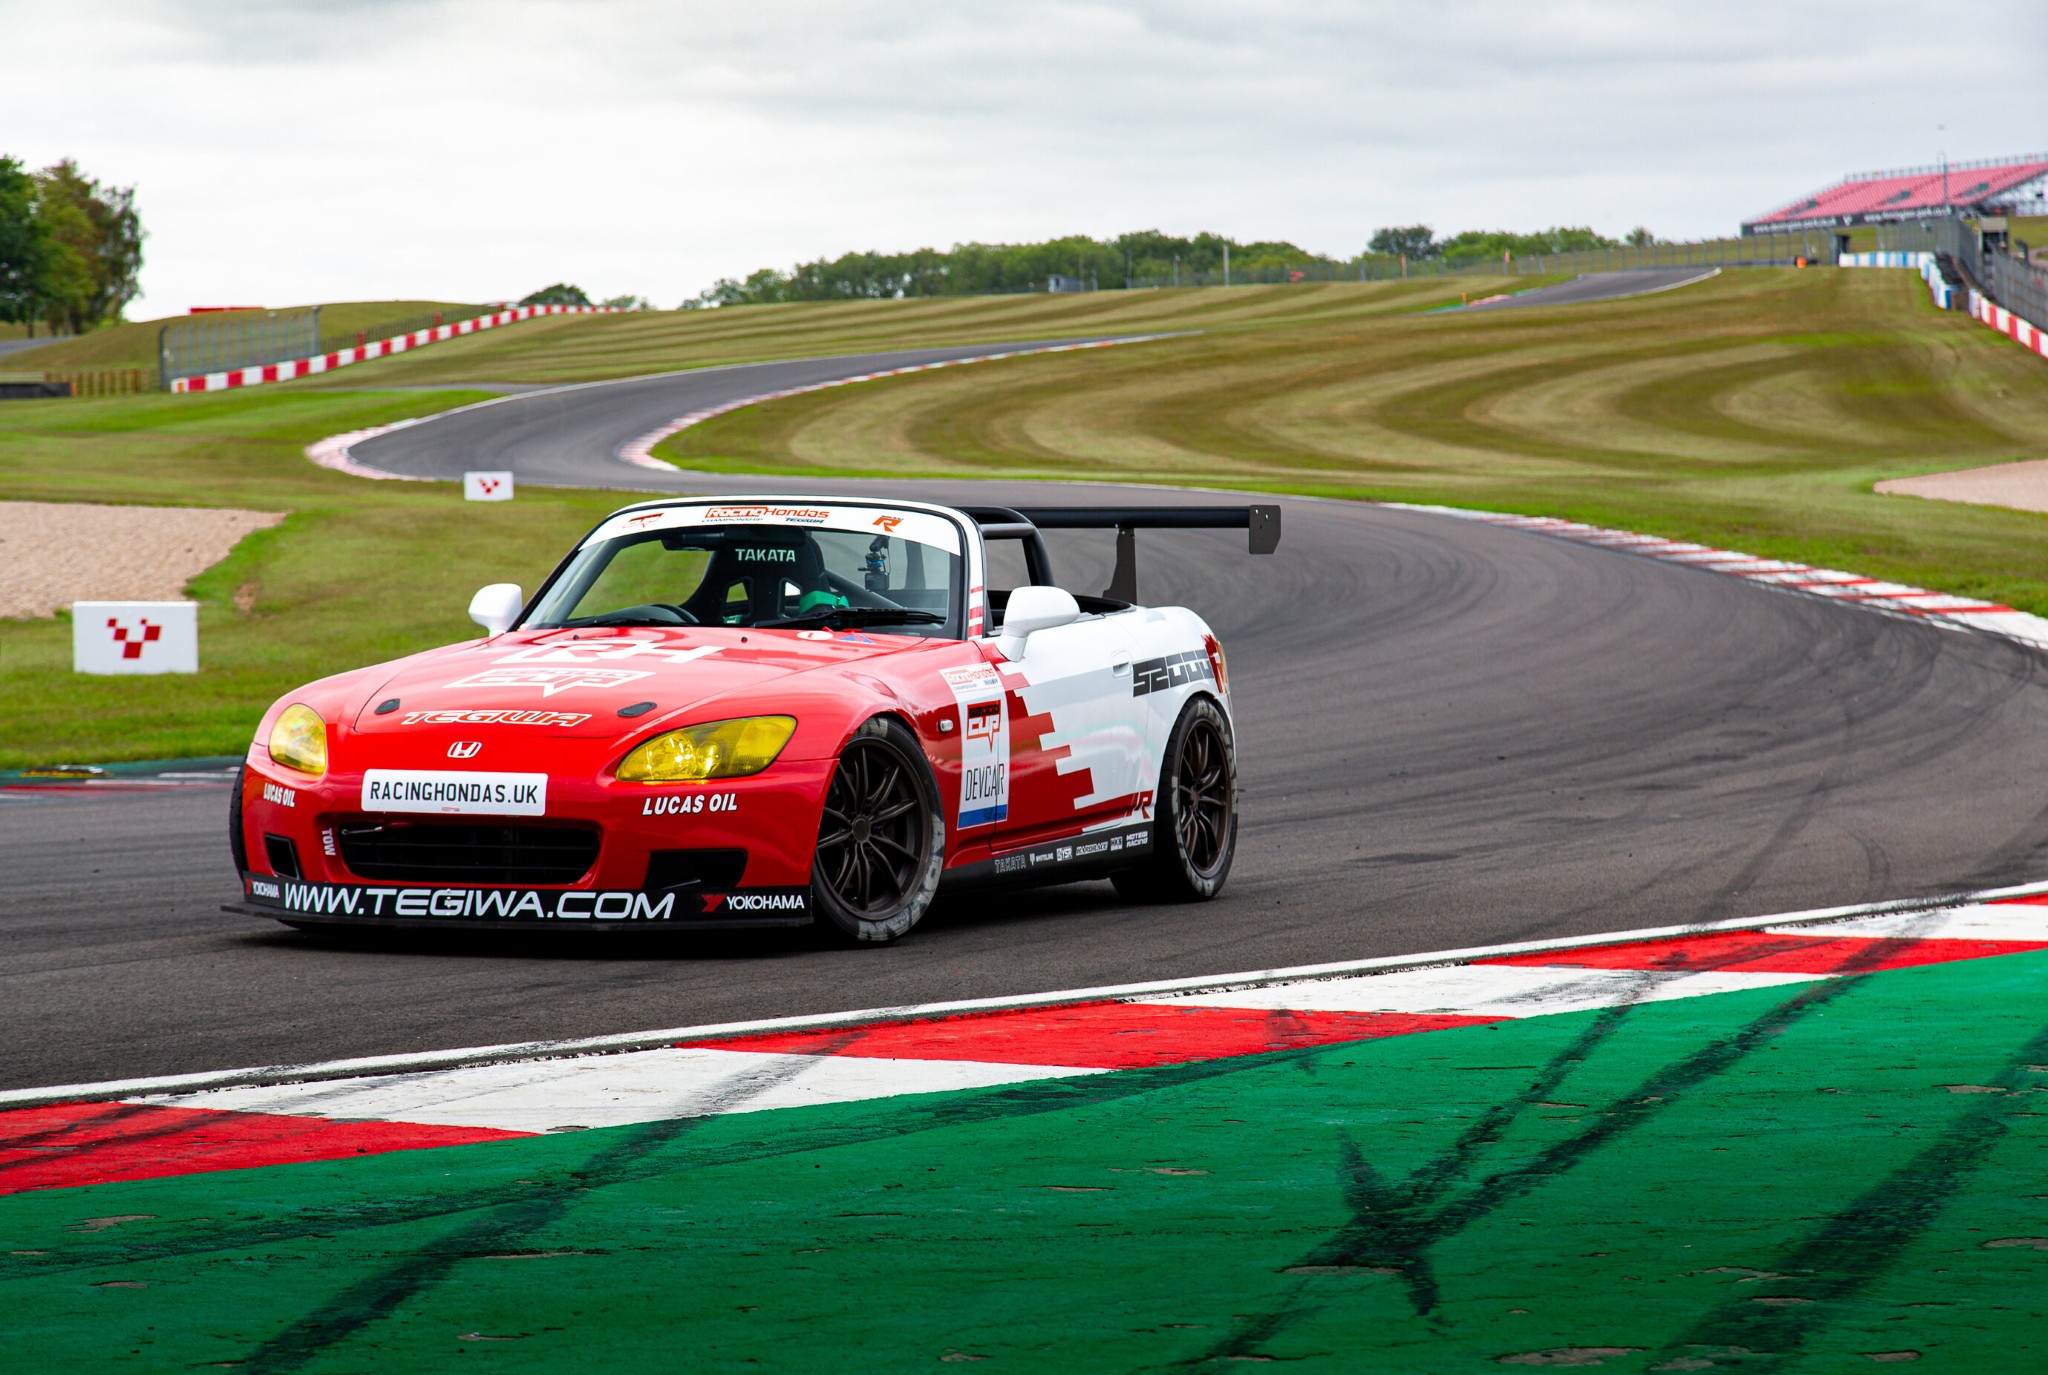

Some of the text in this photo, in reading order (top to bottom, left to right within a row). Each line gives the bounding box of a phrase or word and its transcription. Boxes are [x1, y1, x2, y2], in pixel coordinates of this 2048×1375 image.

[735, 548, 796, 563] TAKATA
[401, 709, 592, 727] TEGIWA
[968, 714, 1000, 743] CUP
[370, 781, 538, 804] RACINGHONDAS.UK
[965, 763, 1005, 801] DEVCAR
[263, 783, 296, 808] LUCAS OIL
[642, 793, 738, 816] LUCAS OIL
[321, 828, 337, 856] TOW
[1126, 830, 1149, 840] MOTEGI
[1126, 837, 1149, 848] RACING
[994, 854, 1027, 873] TAKATA
[284, 883, 676, 919] WWW.TEGIWA.COM
[726, 895, 805, 909] YOKOHAMA
